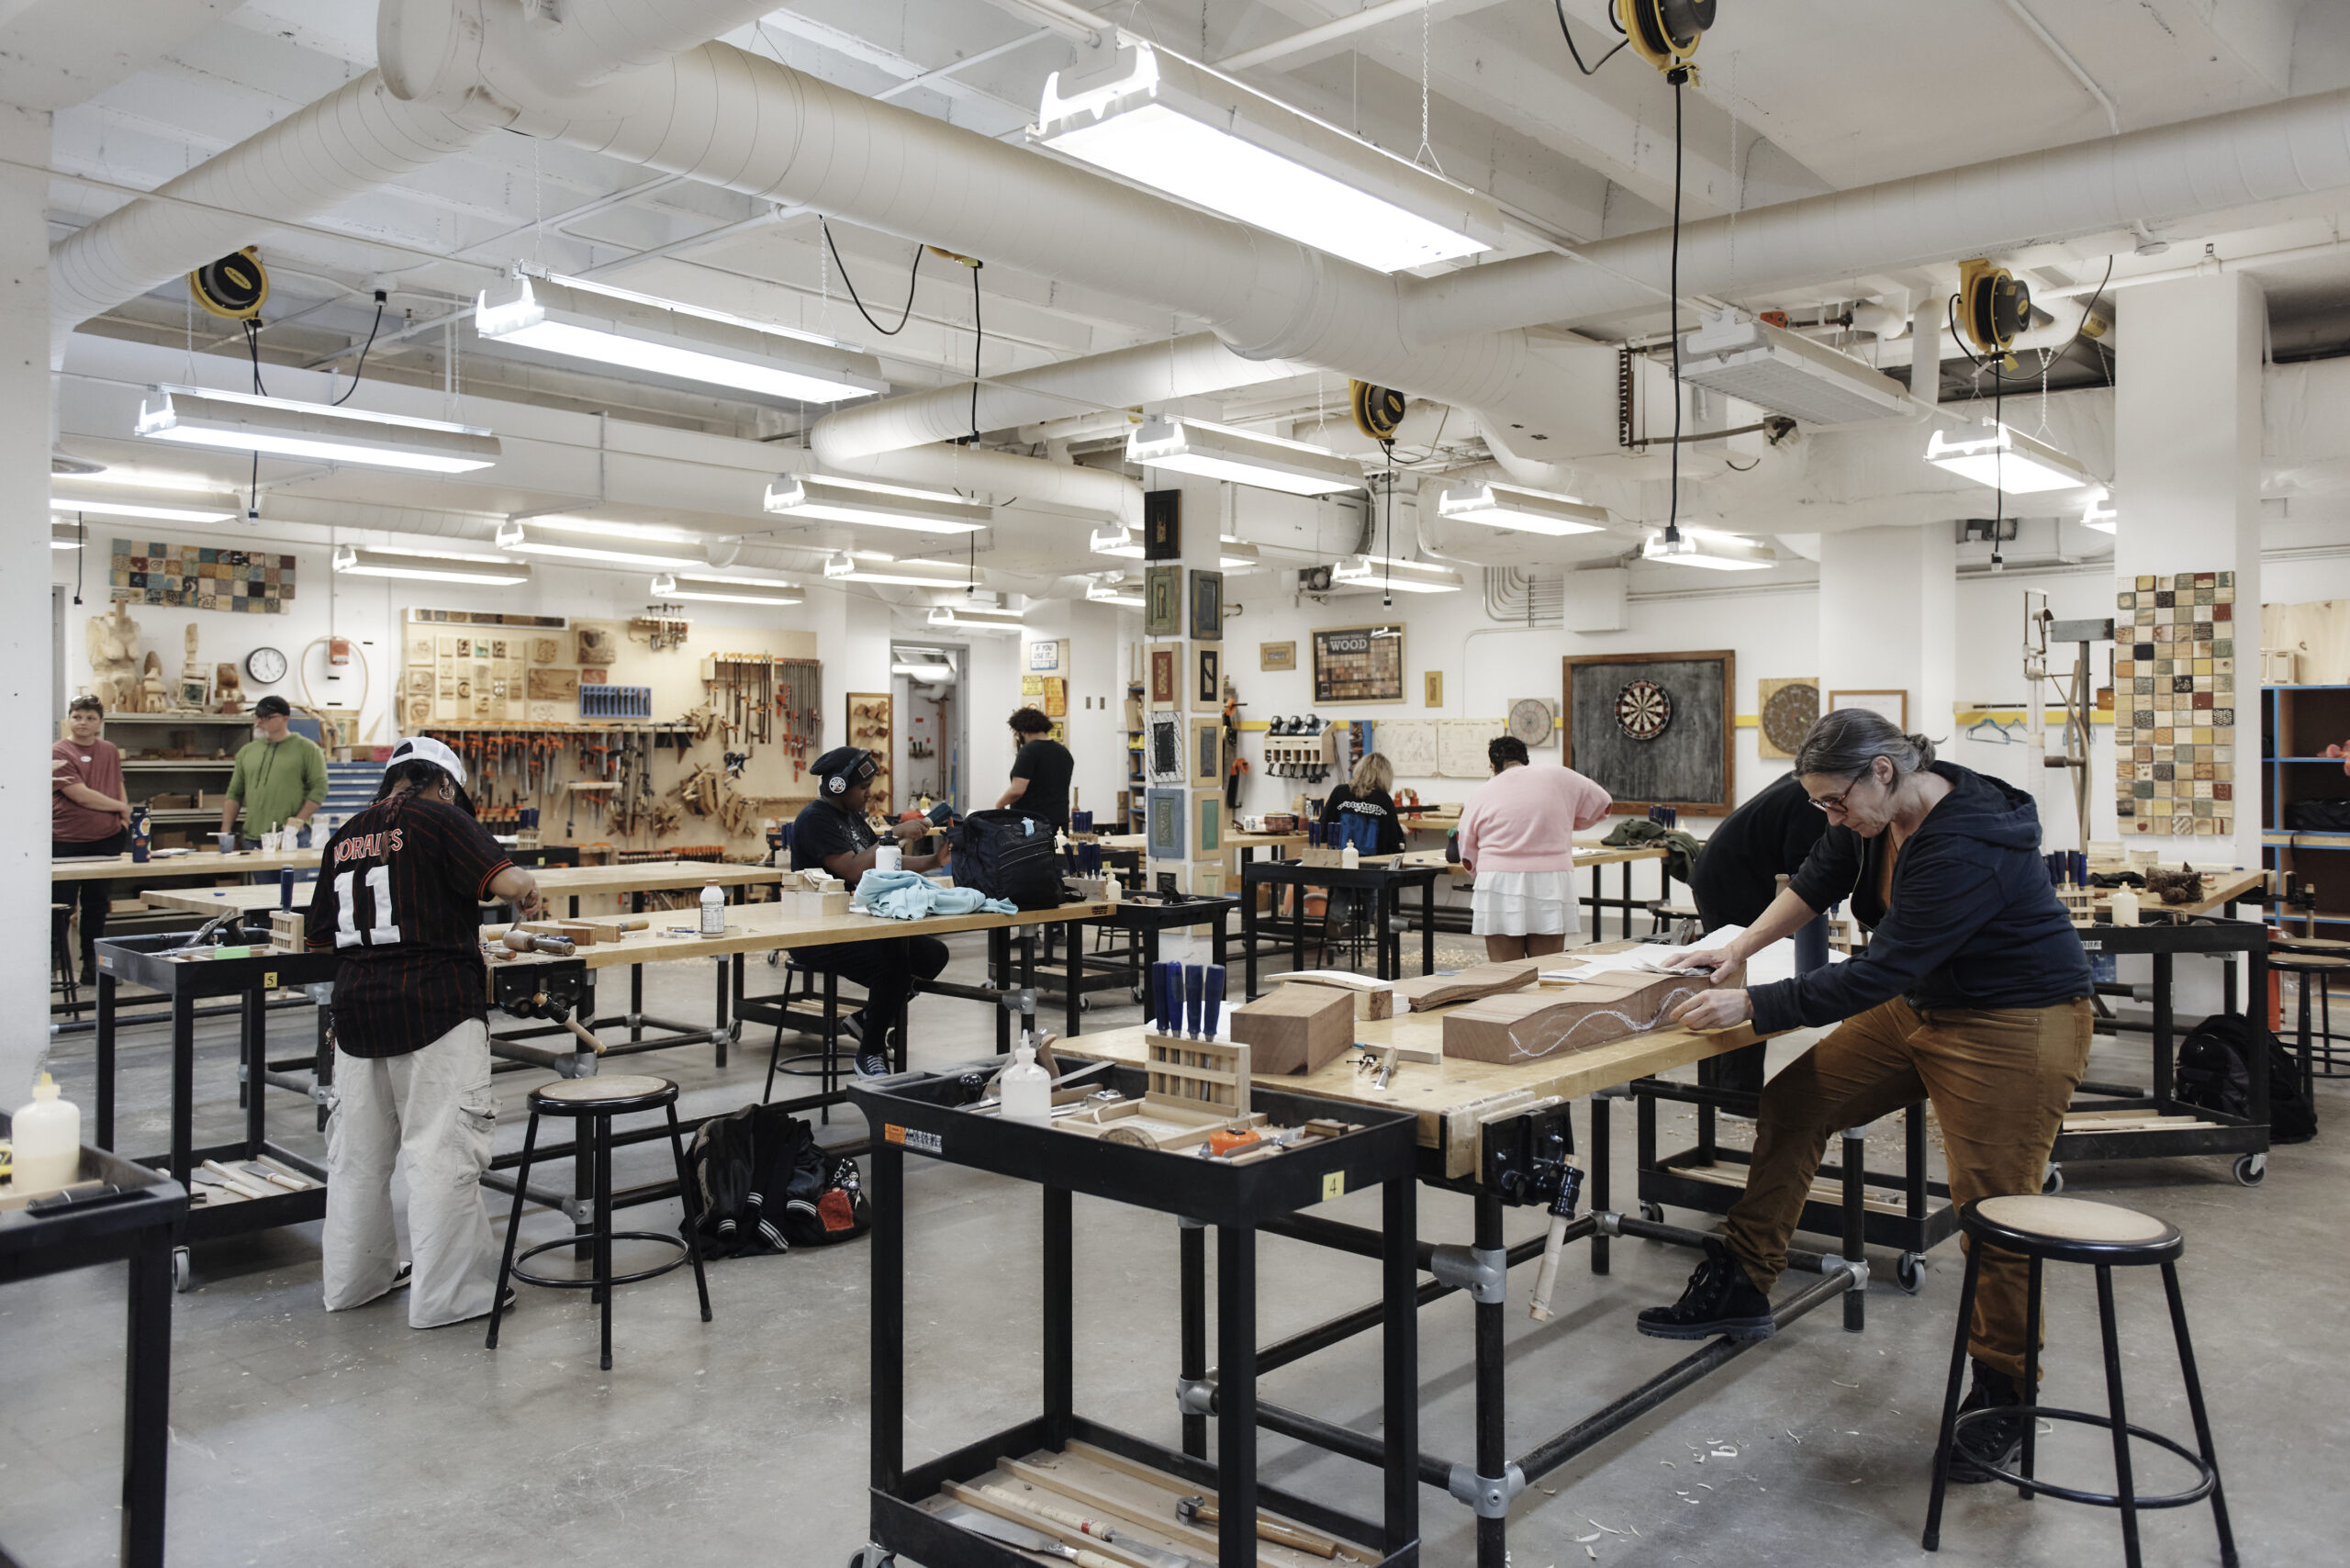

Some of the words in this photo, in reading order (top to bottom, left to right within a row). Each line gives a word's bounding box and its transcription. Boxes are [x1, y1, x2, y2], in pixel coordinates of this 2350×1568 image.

[1329, 639, 1368, 651] WOOD
[333, 828, 403, 868] MORALS
[333, 865, 401, 949] 11
[266, 975, 274, 986] 5
[1329, 1178, 1337, 1195] 4
